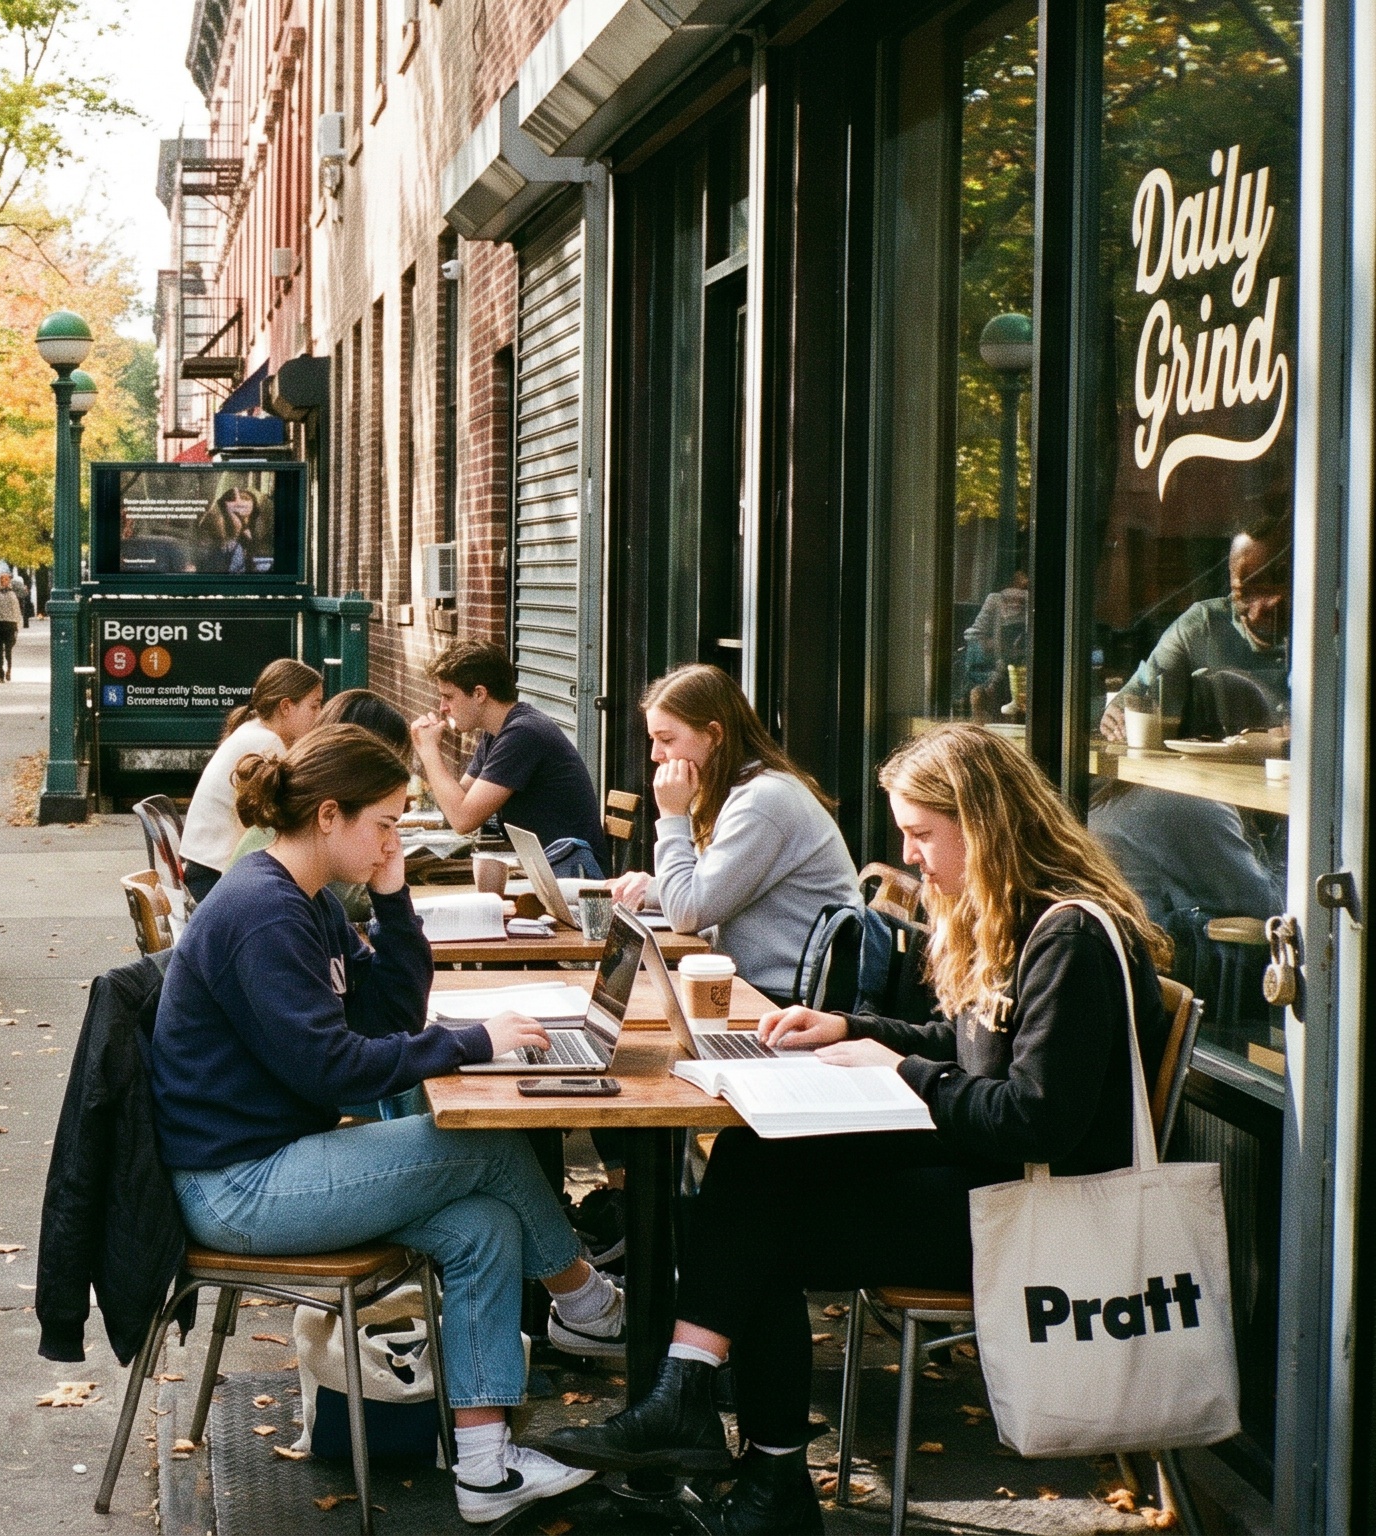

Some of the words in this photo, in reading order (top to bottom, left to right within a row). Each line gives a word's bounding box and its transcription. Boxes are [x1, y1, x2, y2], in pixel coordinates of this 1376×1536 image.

[1132, 144, 1274, 308] Daily
[1135, 276, 1289, 502] Grind
[104, 620, 187, 646] Bergen
[197, 621, 223, 642] St
[1024, 1272, 1202, 1343] Pratt
